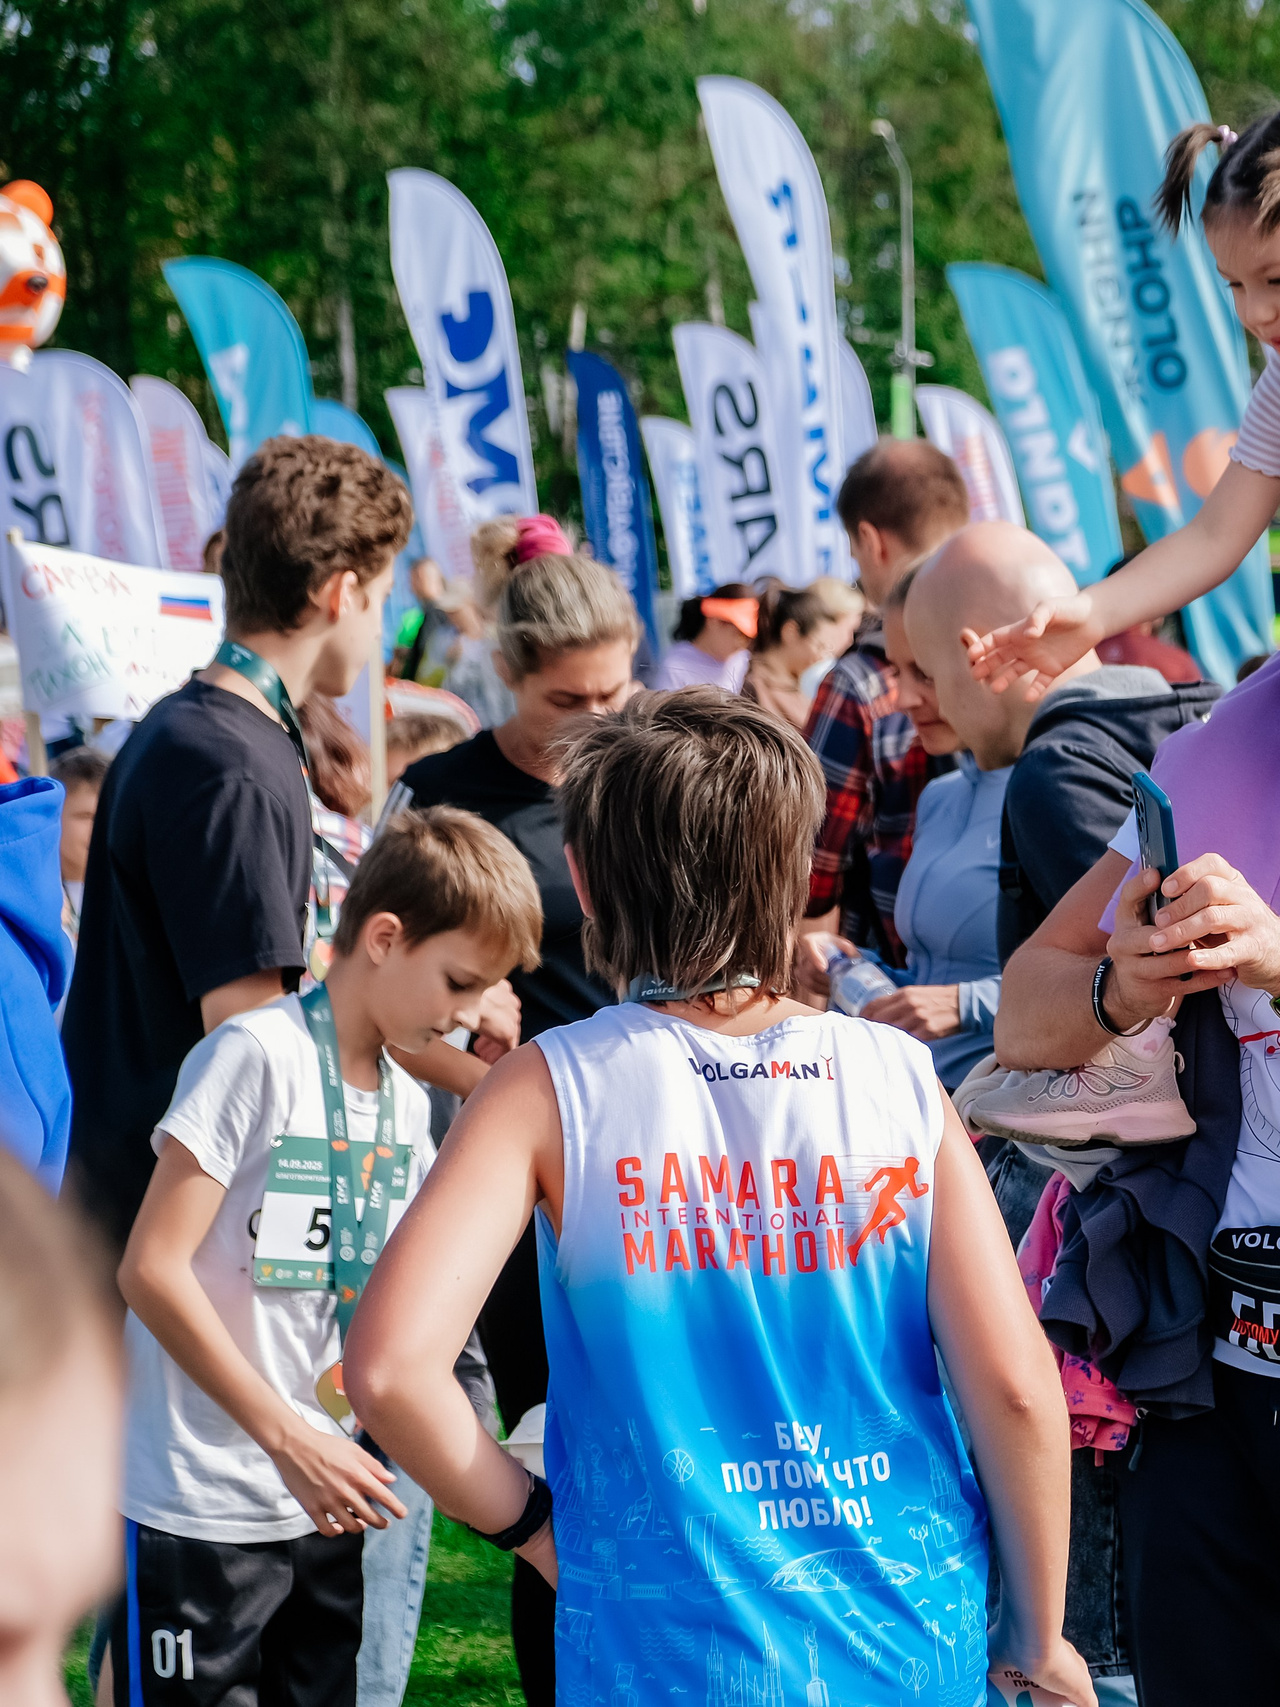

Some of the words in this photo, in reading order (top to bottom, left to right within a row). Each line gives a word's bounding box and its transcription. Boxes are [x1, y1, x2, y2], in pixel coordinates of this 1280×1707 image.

[278, 1158, 323, 1171] 14.09.2025
[616, 1152, 844, 1209] SAMARA
[621, 1207, 845, 1232] INTERNTIONAL
[622, 1227, 845, 1276] MARATHON
[1231, 1317, 1279, 1345] ПОТОМУ
[720, 1458, 830, 1493] ПОТОМ
[832, 1451, 891, 1490] ЧТО
[151, 1628, 194, 1680] 01
[1004, 1670, 1027, 1680] ПО
